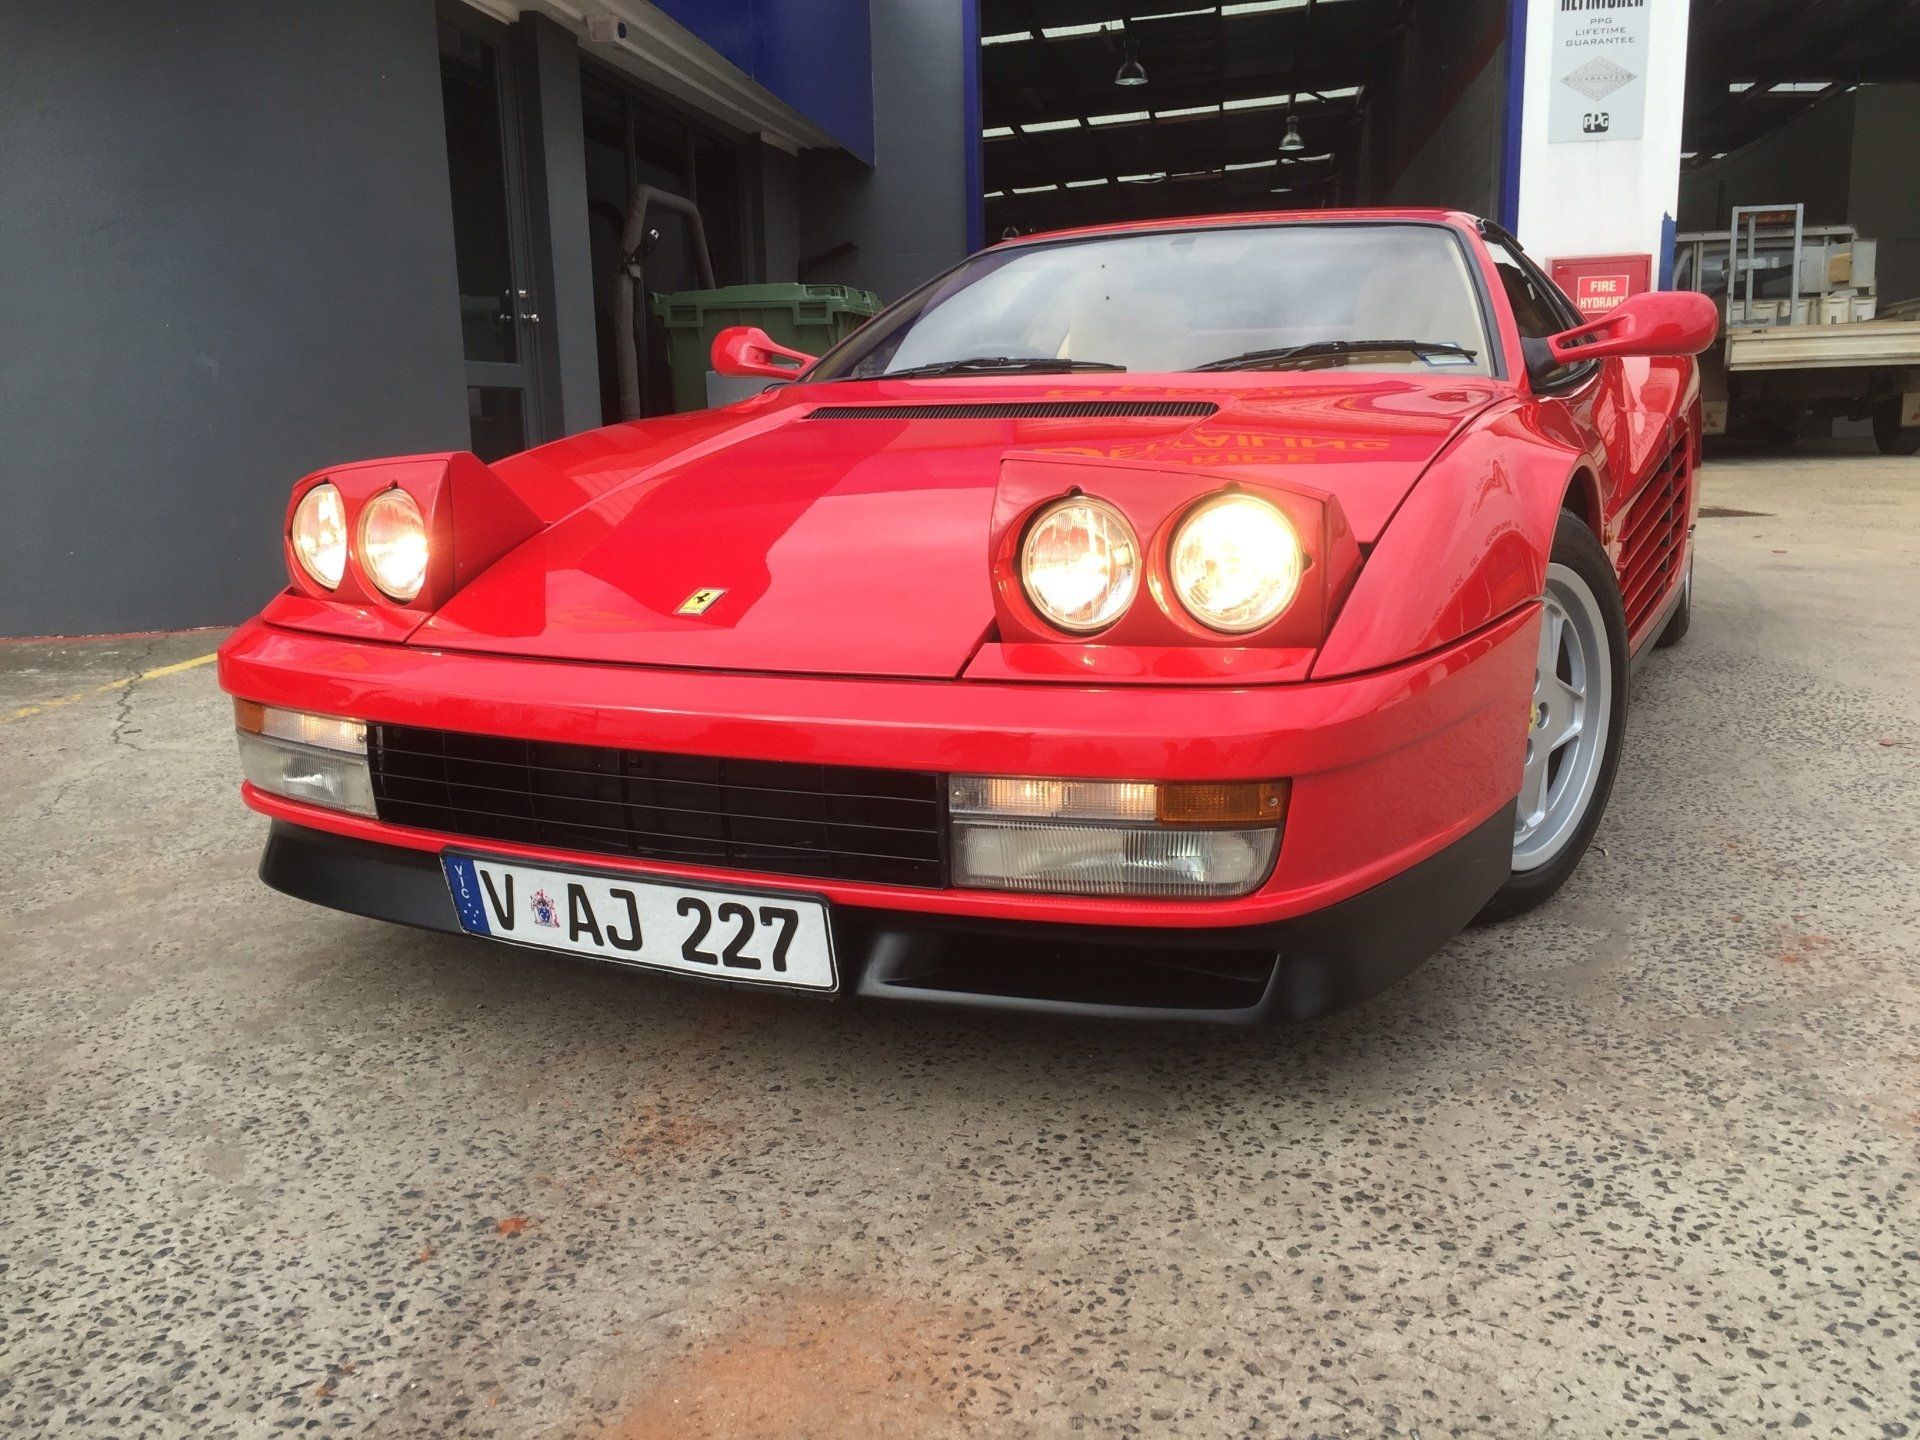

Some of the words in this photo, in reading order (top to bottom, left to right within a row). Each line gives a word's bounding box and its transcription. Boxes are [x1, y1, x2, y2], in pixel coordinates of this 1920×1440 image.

[1590, 17, 1613, 25] PPG
[1575, 26, 1627, 36] LIFETIME
[1565, 36, 1636, 47] GUARANTEE
[1583, 113, 1609, 131] PPG
[1590, 280, 1617, 293] FIRE
[454, 864, 470, 899] VIC
[676, 896, 800, 973] 227
